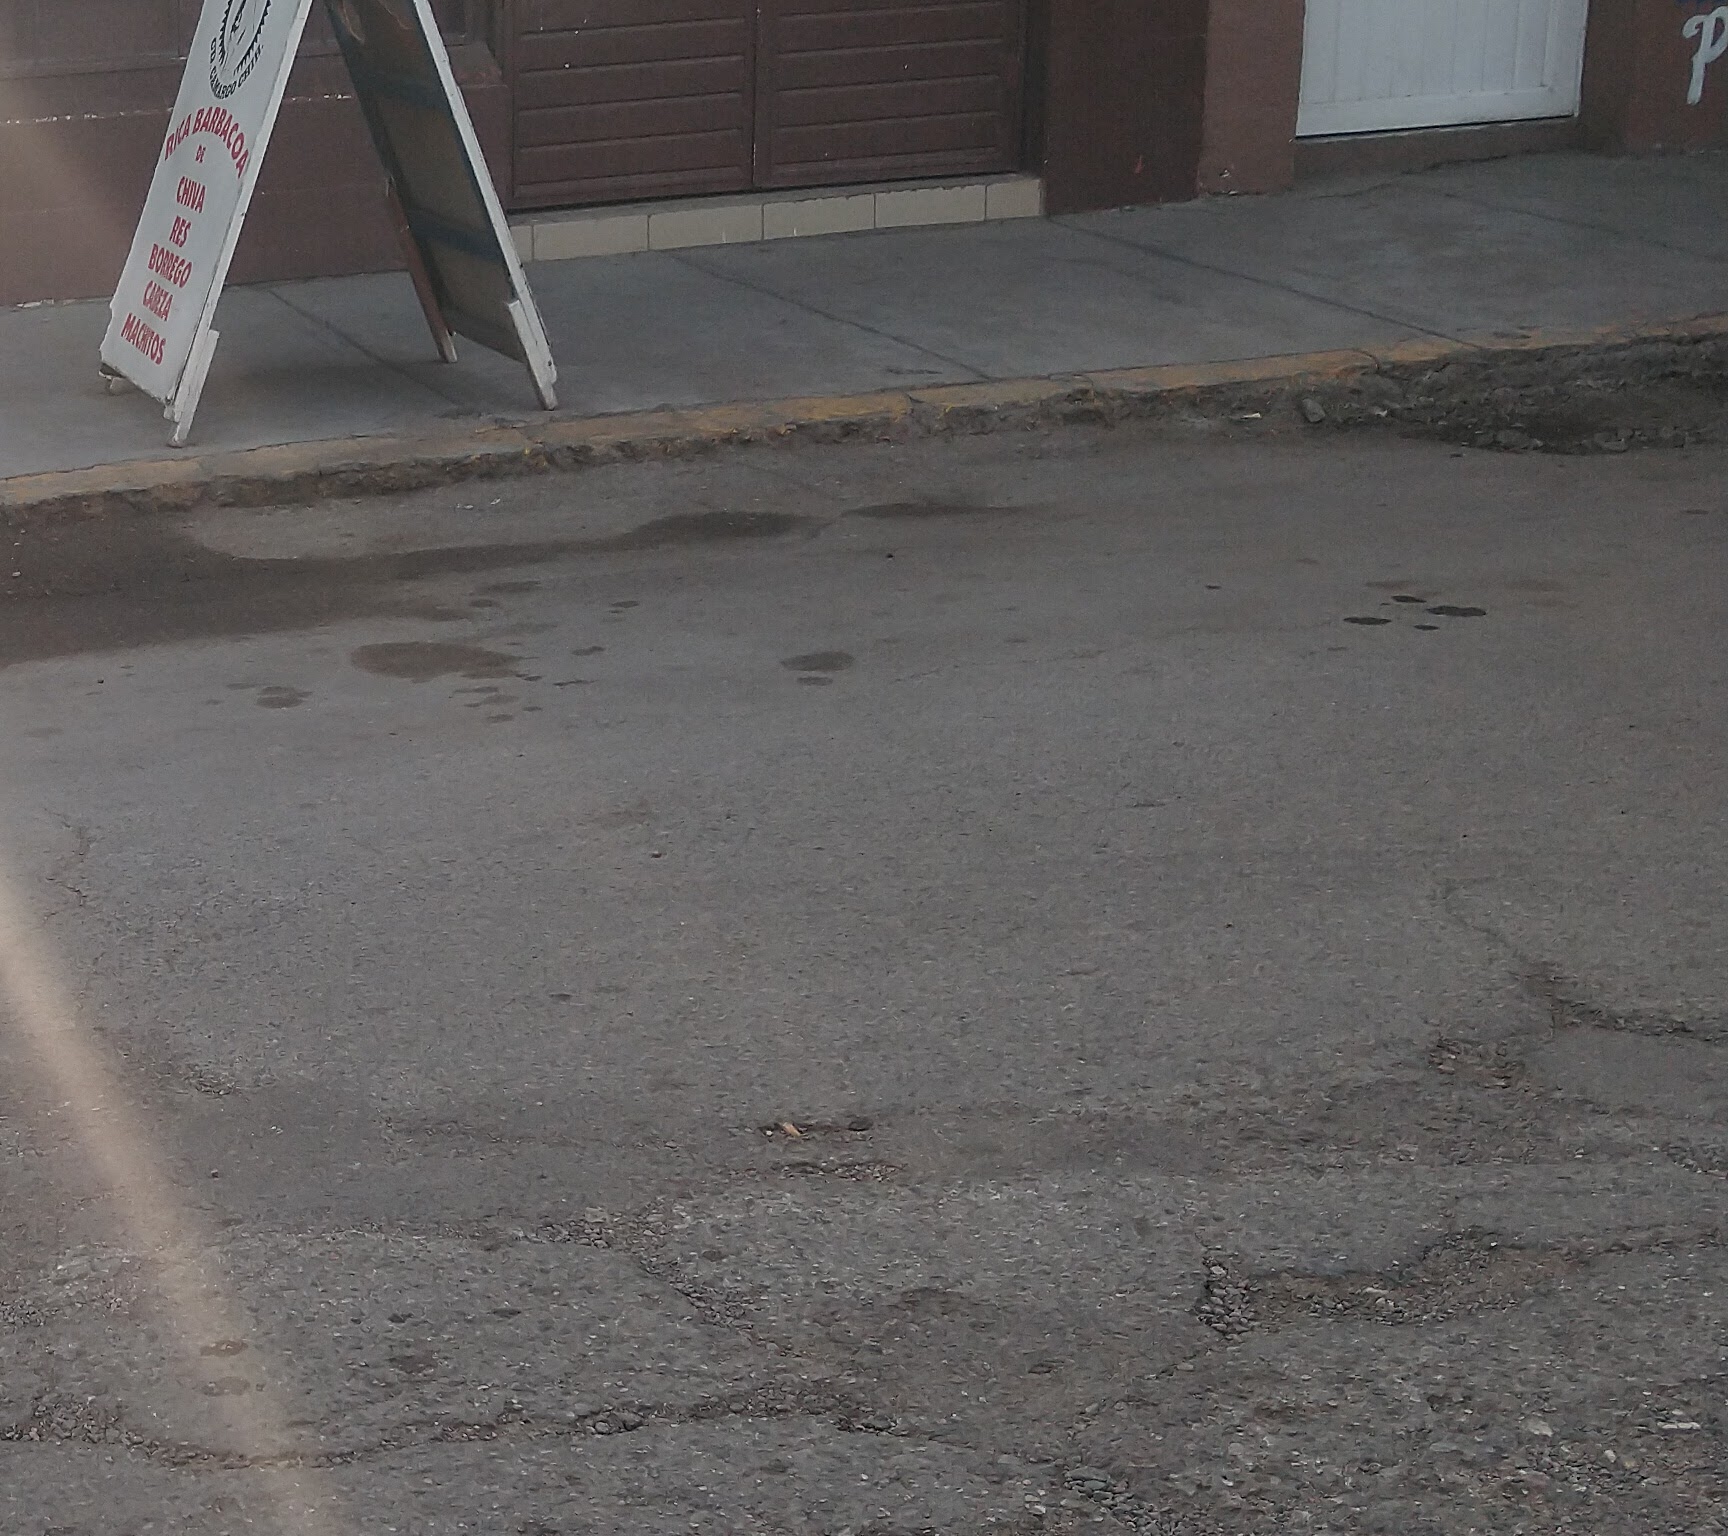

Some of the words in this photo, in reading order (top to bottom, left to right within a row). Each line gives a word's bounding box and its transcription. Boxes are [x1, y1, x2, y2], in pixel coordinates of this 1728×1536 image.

[164, 113, 193, 161] RICA
[192, 106, 251, 179] BARBACOA
[195, 144, 206, 164] DE
[175, 175, 207, 214] CHIVA
[169, 214, 192, 248] RES
[147, 243, 193, 289] BORREGO
[142, 280, 174, 322] CABEZA
[120, 312, 166, 366] MACHITOS
